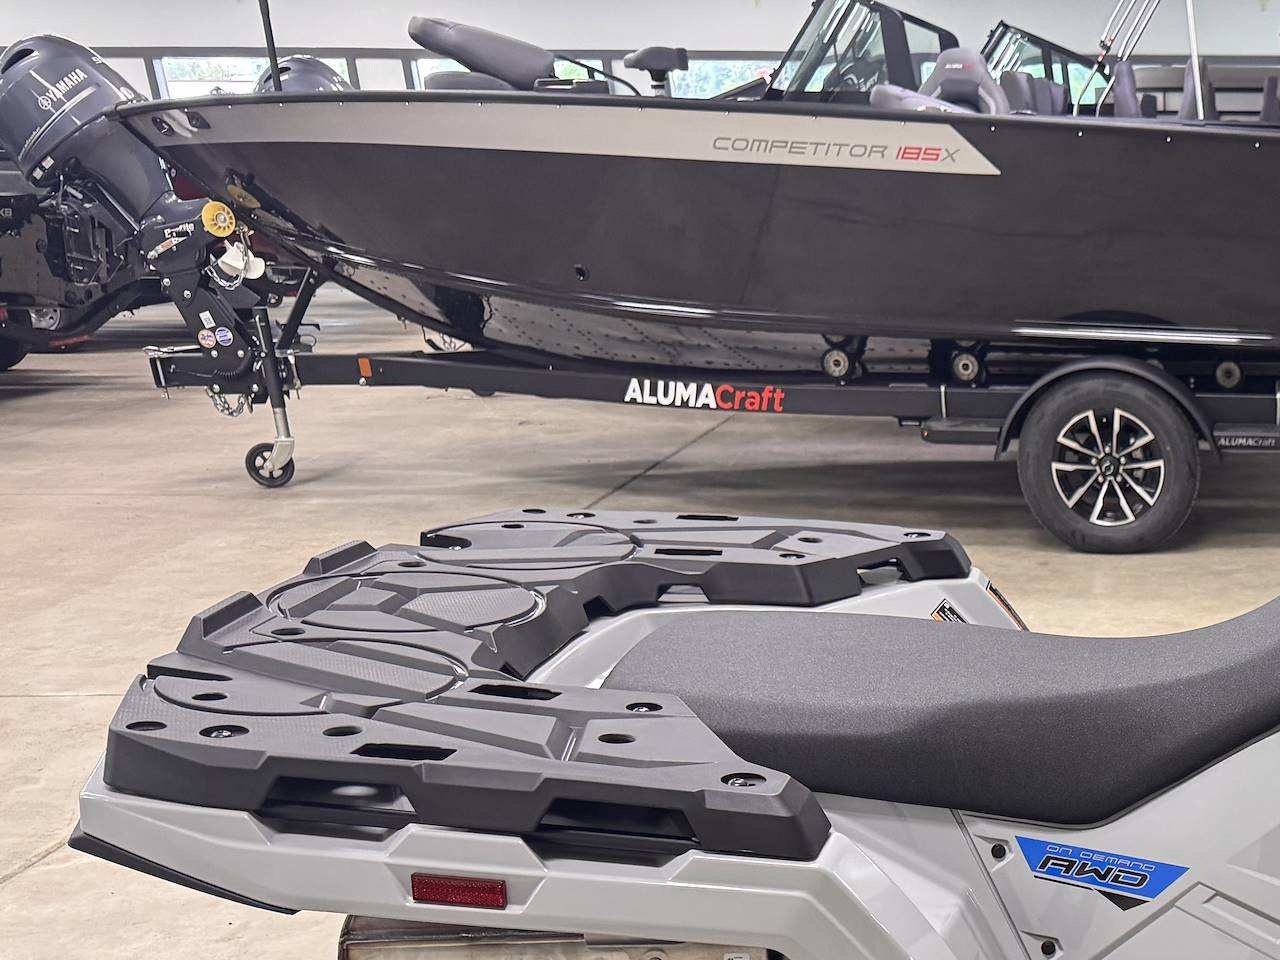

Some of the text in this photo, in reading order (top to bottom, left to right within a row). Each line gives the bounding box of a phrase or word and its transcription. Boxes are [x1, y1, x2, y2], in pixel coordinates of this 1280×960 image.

[45, 68, 88, 102] YAMAHA
[712, 136, 888, 159] COMPETITOR
[624, 377, 785, 412] ALUMACraft
[1037, 854, 1151, 889] AWD
[1046, 844, 1156, 873] ON DEMAND
